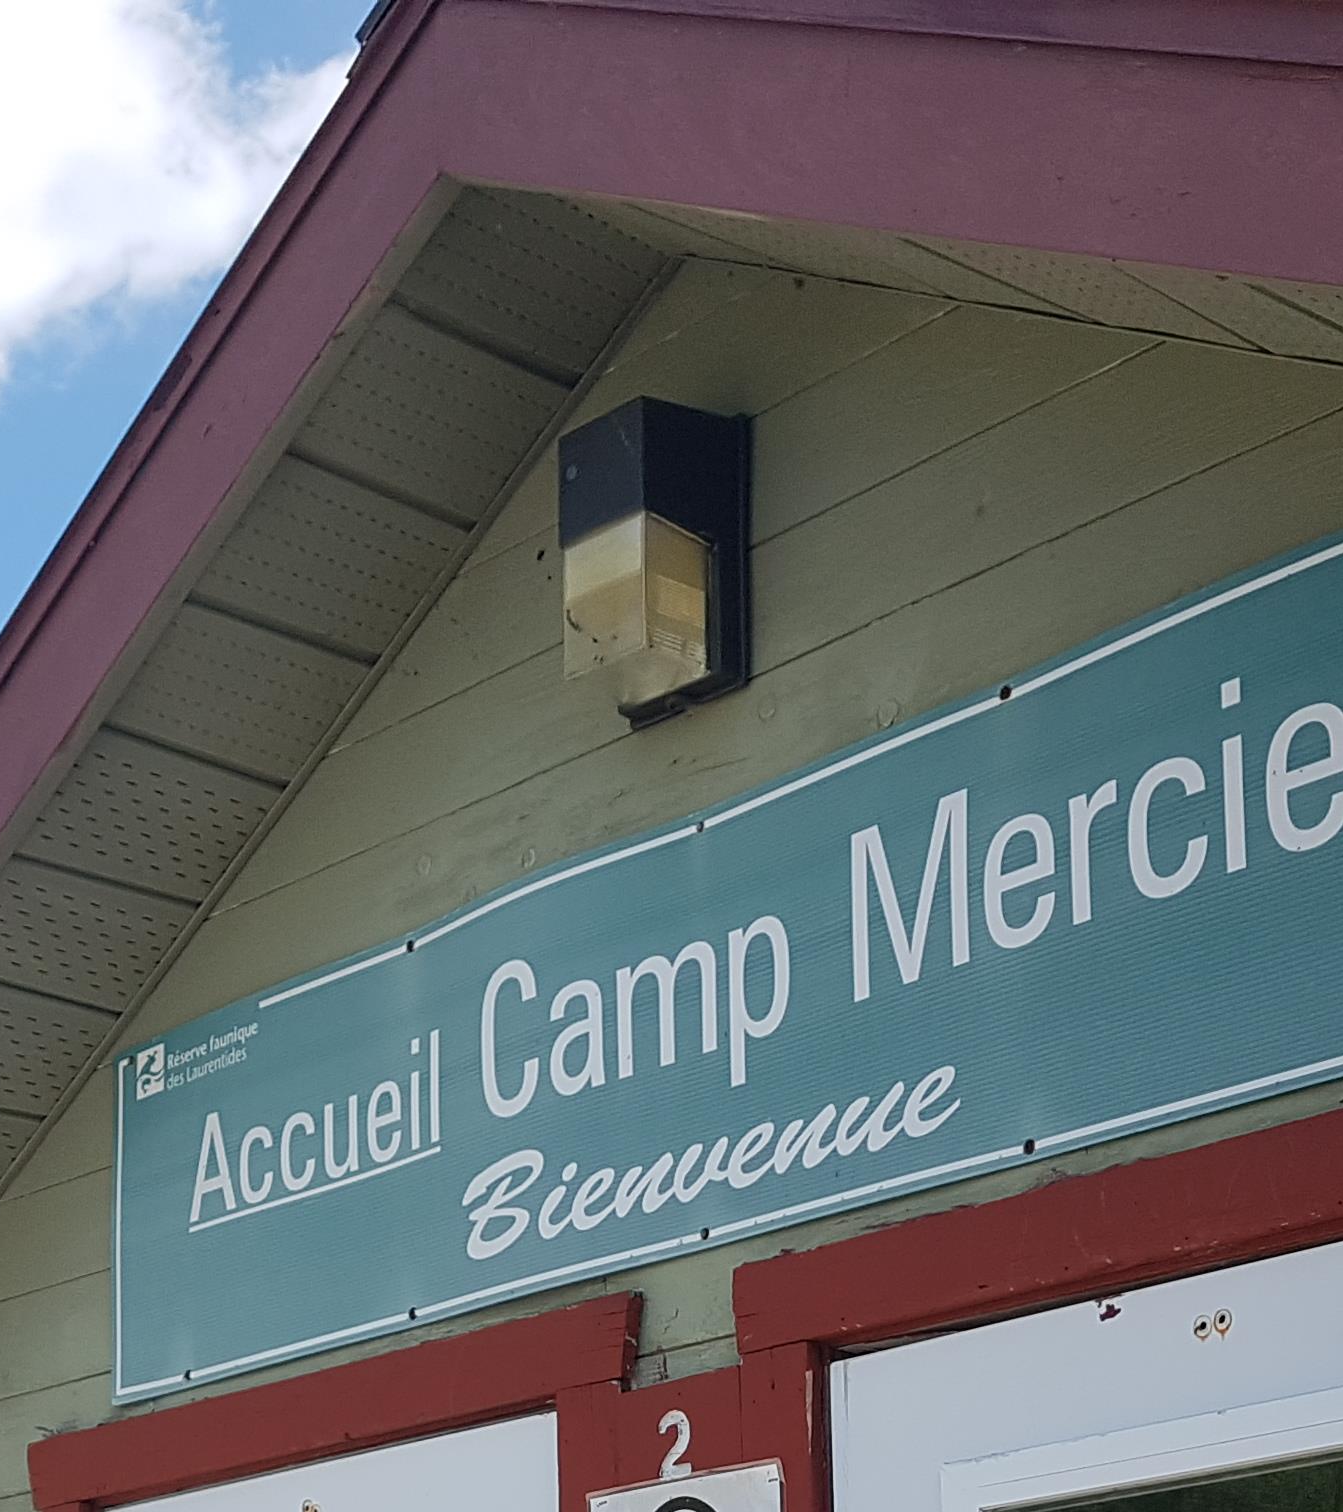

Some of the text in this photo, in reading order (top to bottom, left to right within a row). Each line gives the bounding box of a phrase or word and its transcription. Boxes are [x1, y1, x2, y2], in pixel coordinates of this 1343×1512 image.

[166, 1022, 259, 1069] Réserve faunique
[166, 1046, 248, 1090] des Laurentides
[189, 1028, 440, 1223] Accueil
[481, 914, 790, 1119] Camp
[462, 1065, 961, 1261] Bienvenue
[658, 1409, 693, 1479] 2
